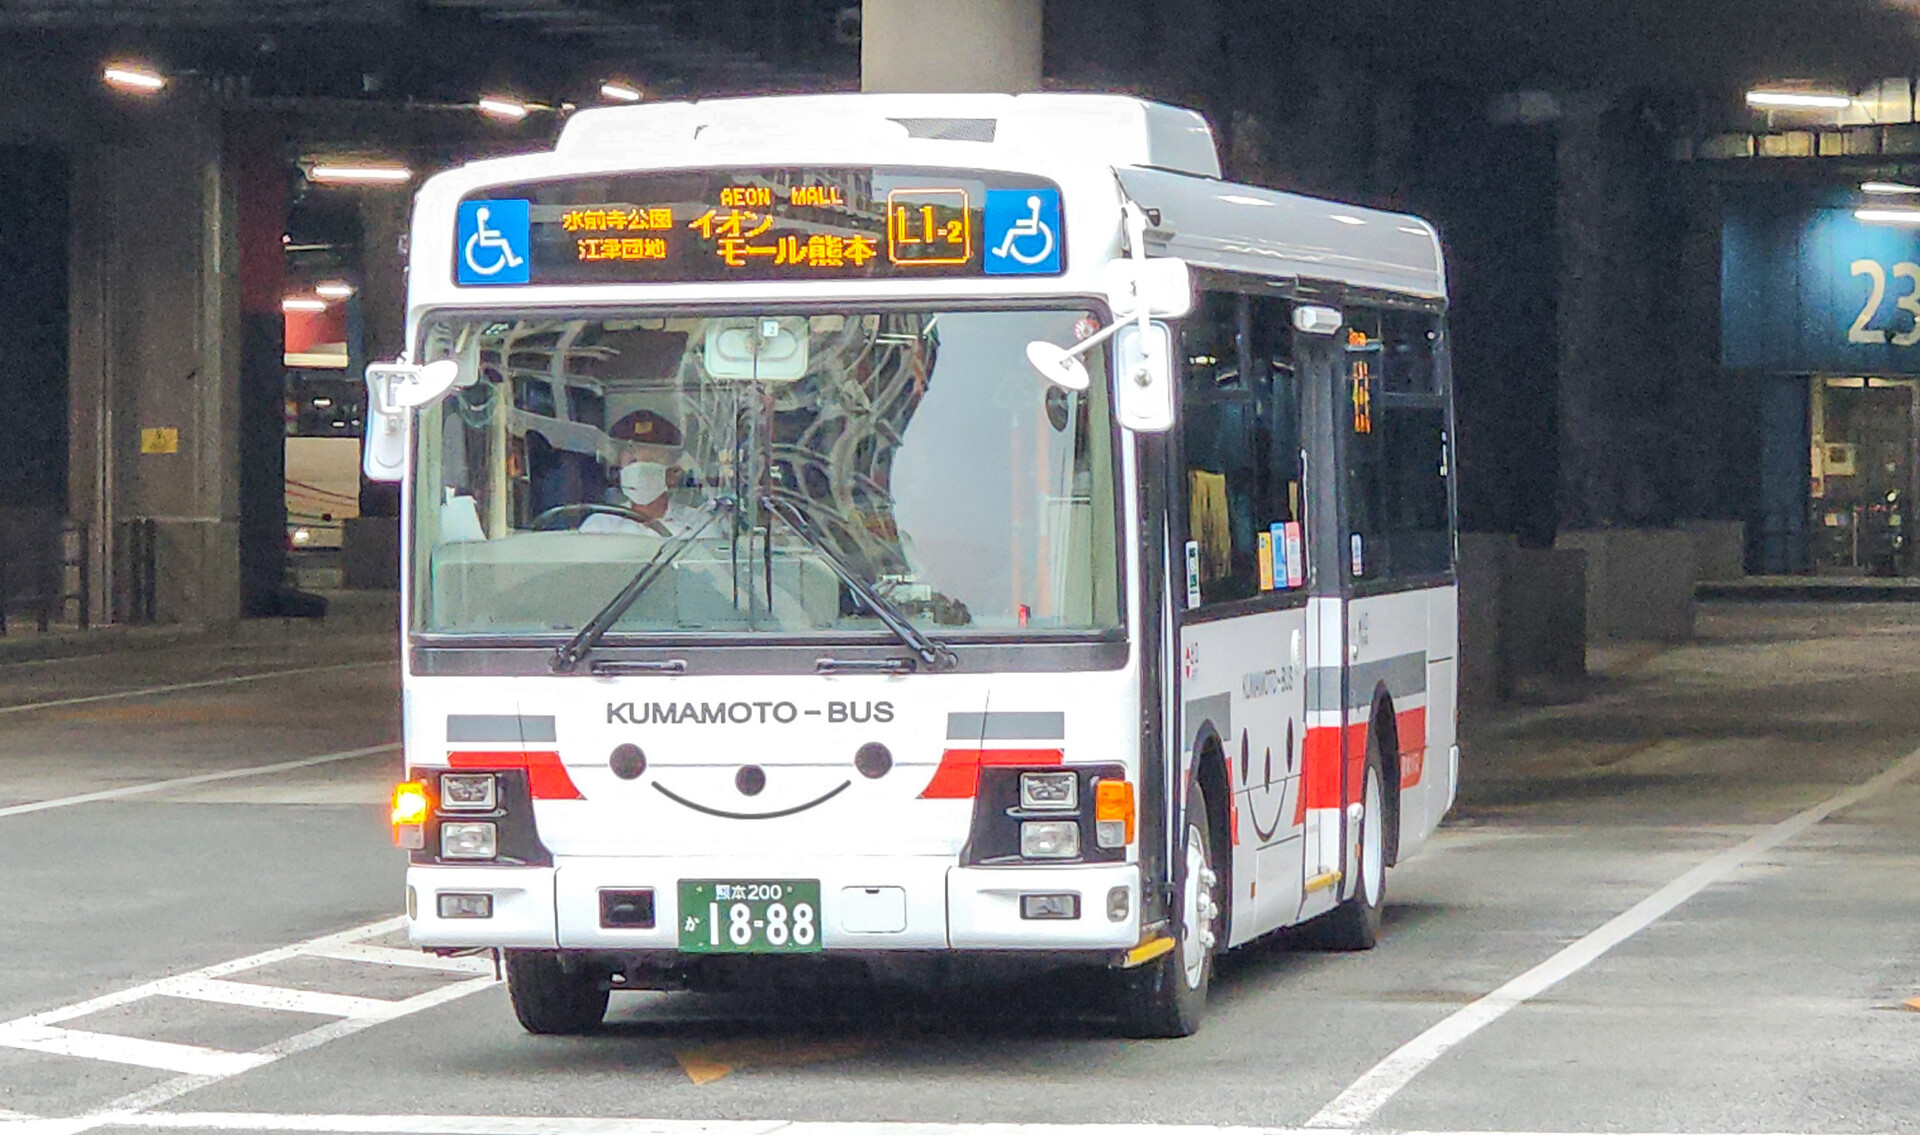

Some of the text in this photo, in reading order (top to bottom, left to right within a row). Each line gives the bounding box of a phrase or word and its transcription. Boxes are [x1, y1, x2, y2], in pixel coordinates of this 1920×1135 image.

[720, 186, 843, 206] AEON MALL
[562, 208, 673, 231] 水前寺公園
[688, 208, 774, 239] イオン
[897, 205, 963, 244] L1-2
[716, 234, 877, 267] モール熊本
[1848, 258, 1920, 346] 23
[709, 902, 815, 946] 18-88
